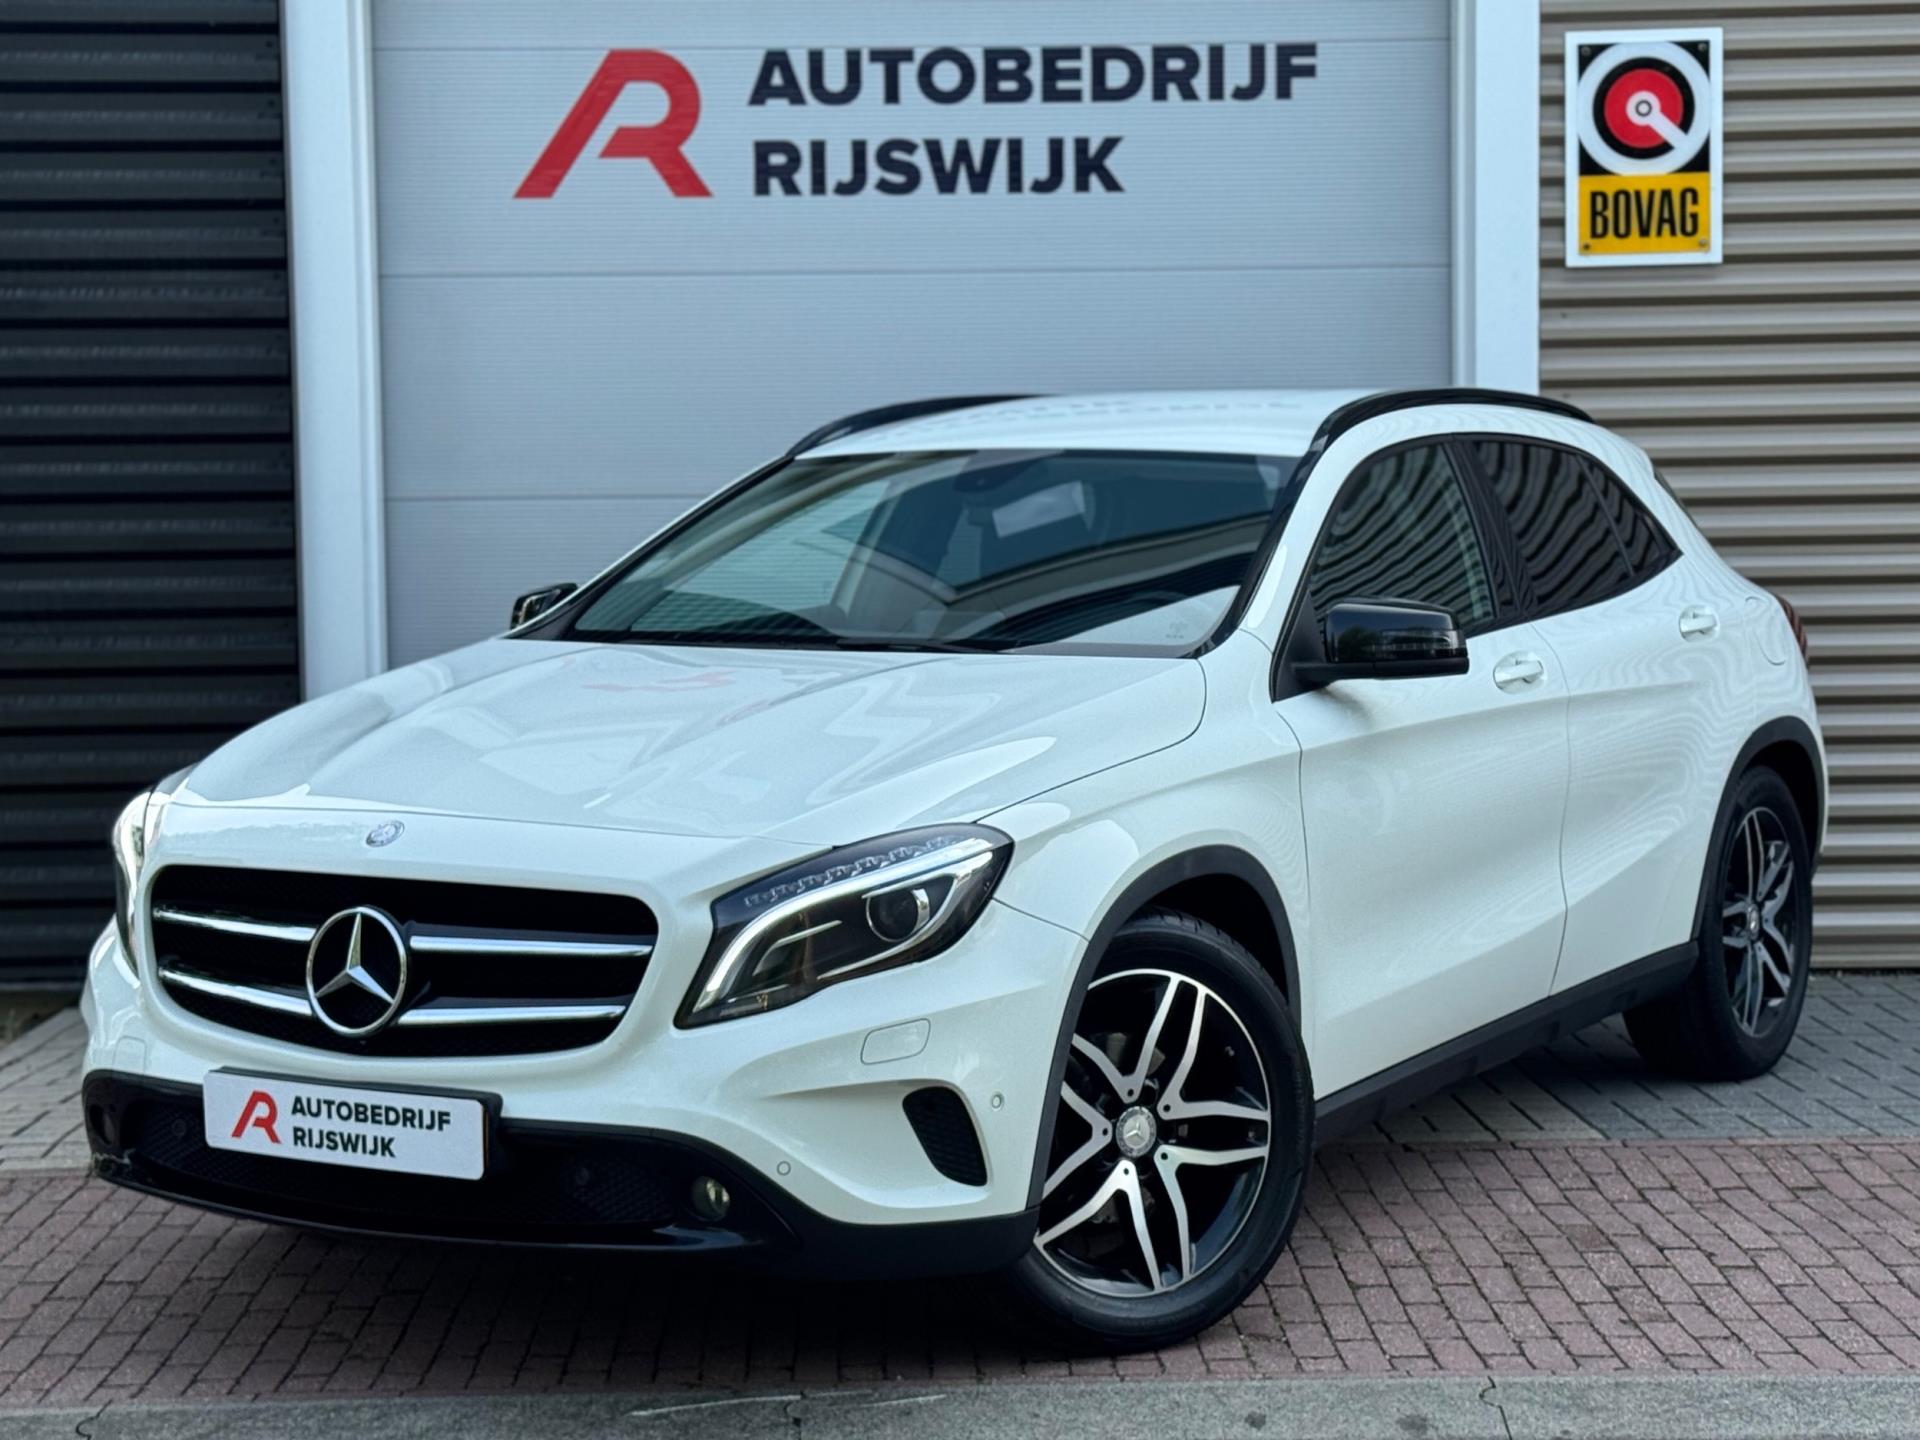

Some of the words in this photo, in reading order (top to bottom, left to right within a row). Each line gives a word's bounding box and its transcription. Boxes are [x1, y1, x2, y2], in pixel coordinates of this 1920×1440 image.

[748, 43, 1317, 106] AUTOBEDRIJF
[753, 136, 1125, 196] RIJSWIJK
[1589, 187, 1699, 240] BOVAG
[291, 1095, 451, 1132] AUTOBEDRIJF
[292, 1126, 396, 1158] RIJSWIJK
